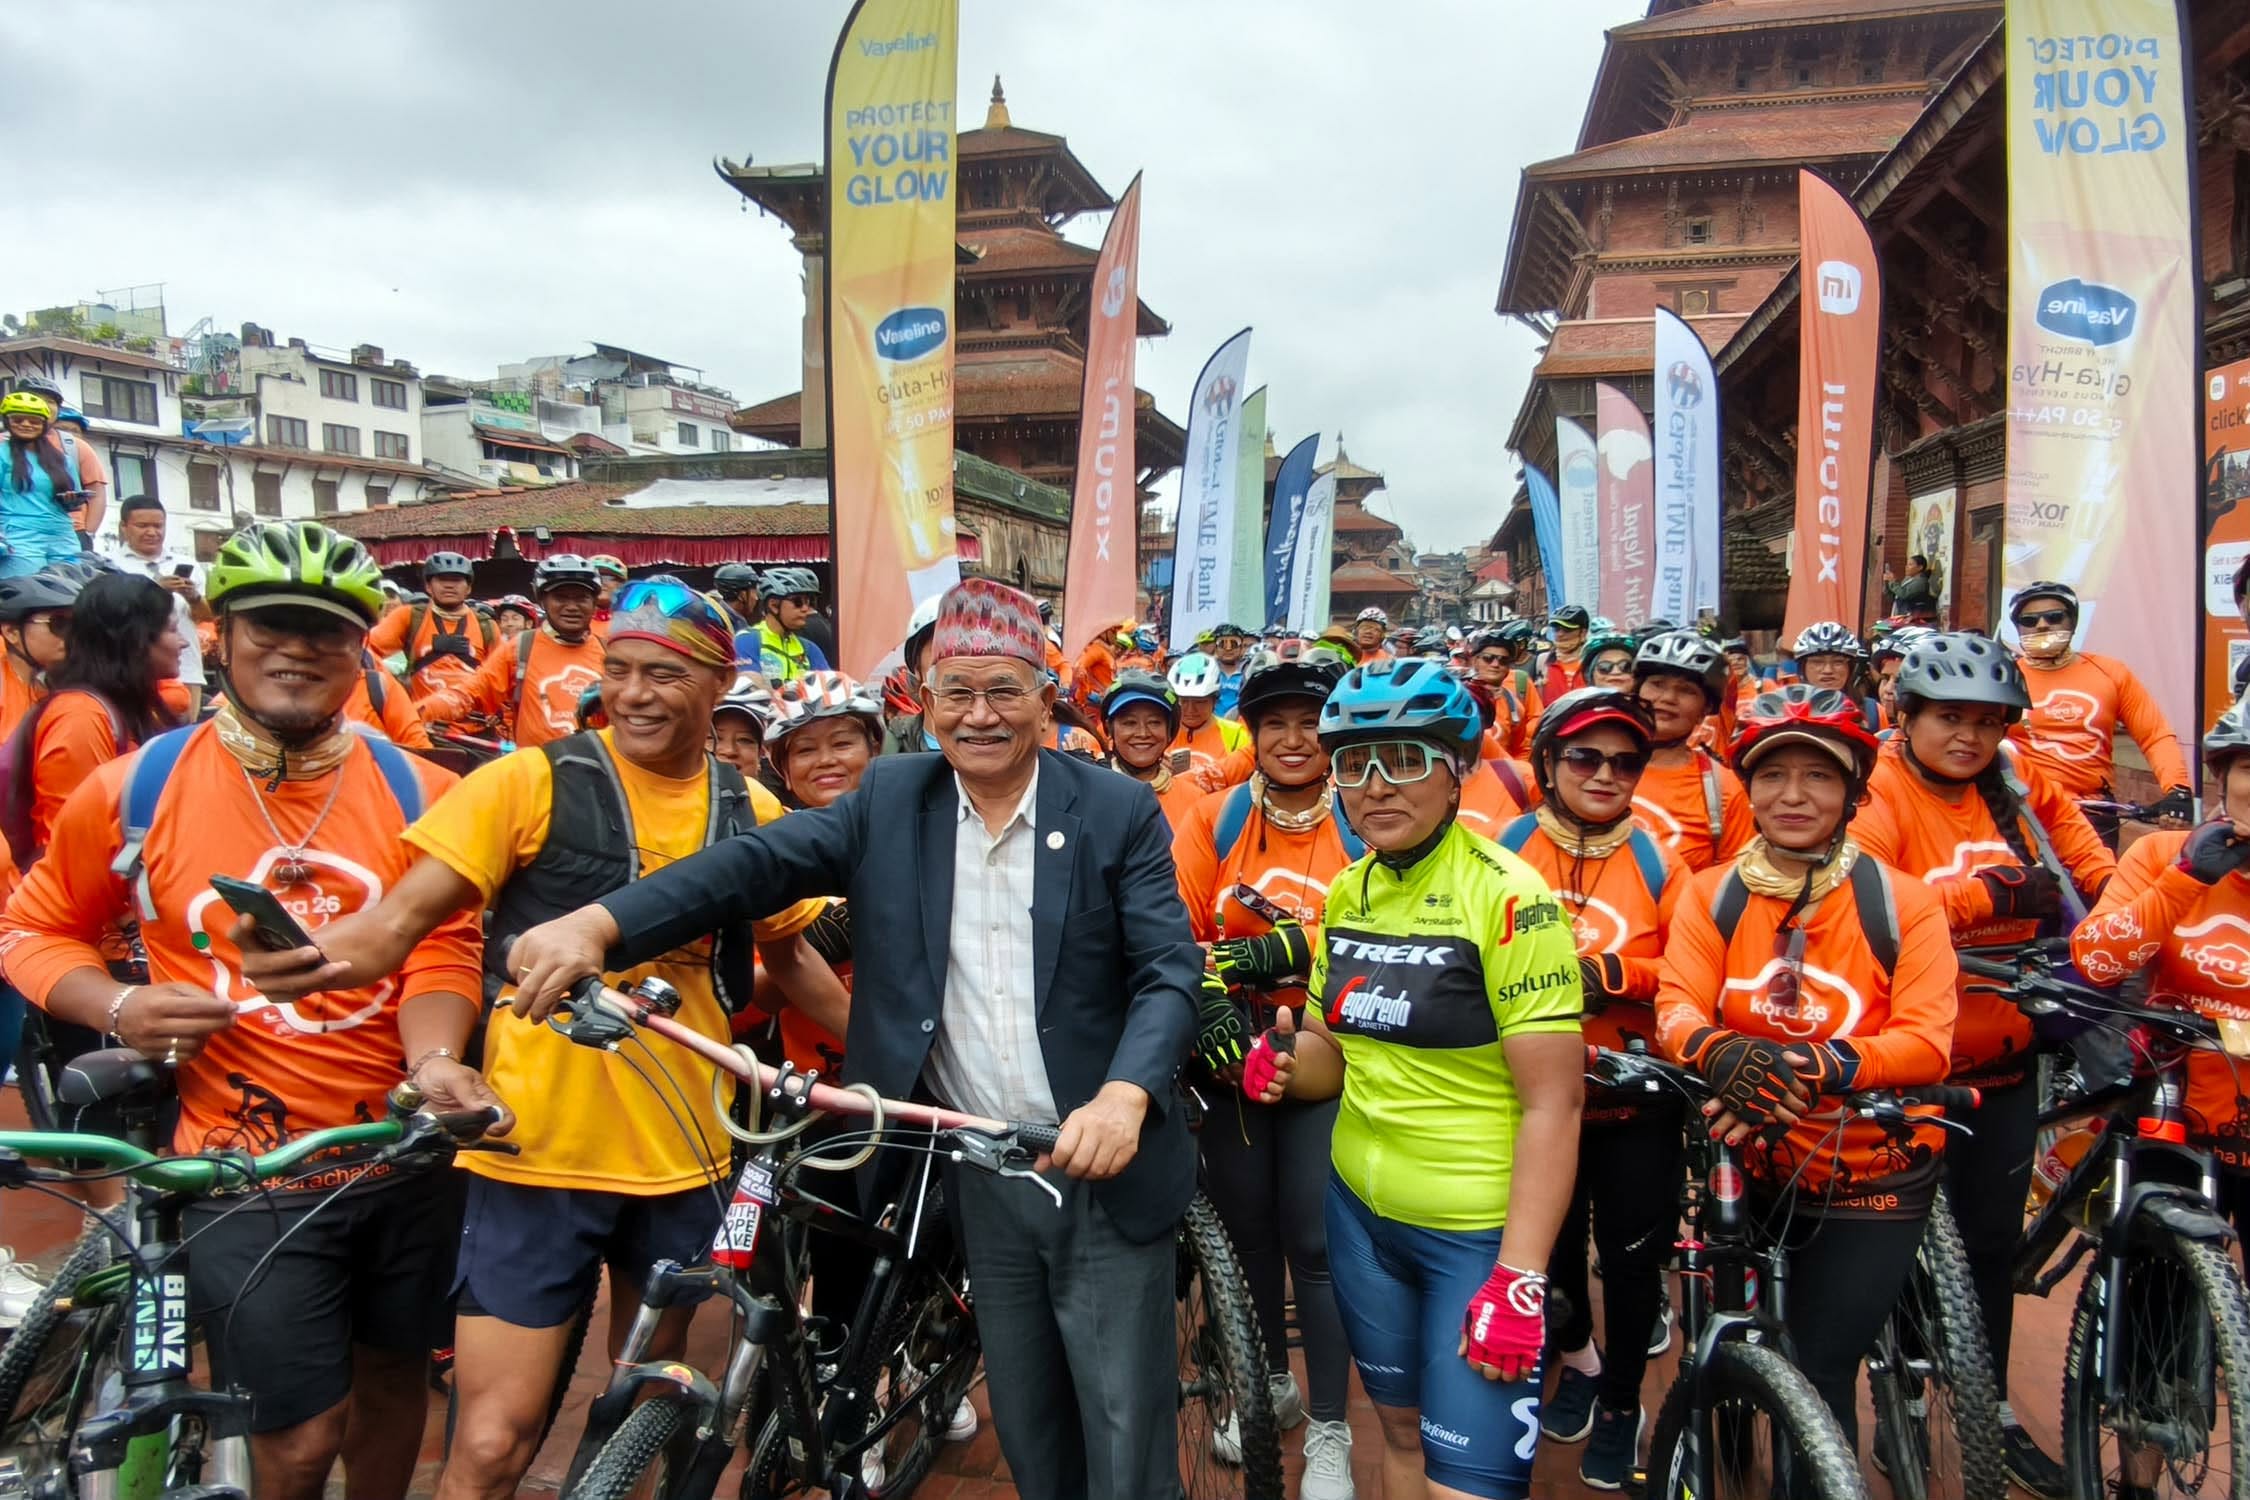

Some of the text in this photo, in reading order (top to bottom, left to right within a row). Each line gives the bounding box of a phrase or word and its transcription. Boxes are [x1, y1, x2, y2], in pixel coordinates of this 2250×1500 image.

[859, 31, 938, 57] Vaseline
[846, 100, 951, 129] PROTECT
[848, 129, 949, 168] YOUR
[847, 169, 949, 207] GLOW
[879, 320, 942, 346] Vaseline
[2211, 406, 2245, 432] click
[1817, 382, 1845, 584] xiaomi
[1198, 556, 1216, 613] Bank
[1469, 847, 1508, 876] TREK
[312, 896, 341, 913] 26
[1329, 936, 1454, 966] TREK
[2180, 943, 2237, 972] kora
[1327, 976, 1412, 1028] Segafredo
[1803, 1005, 1828, 1022] 26
[162, 1275, 186, 1369] BENZ
